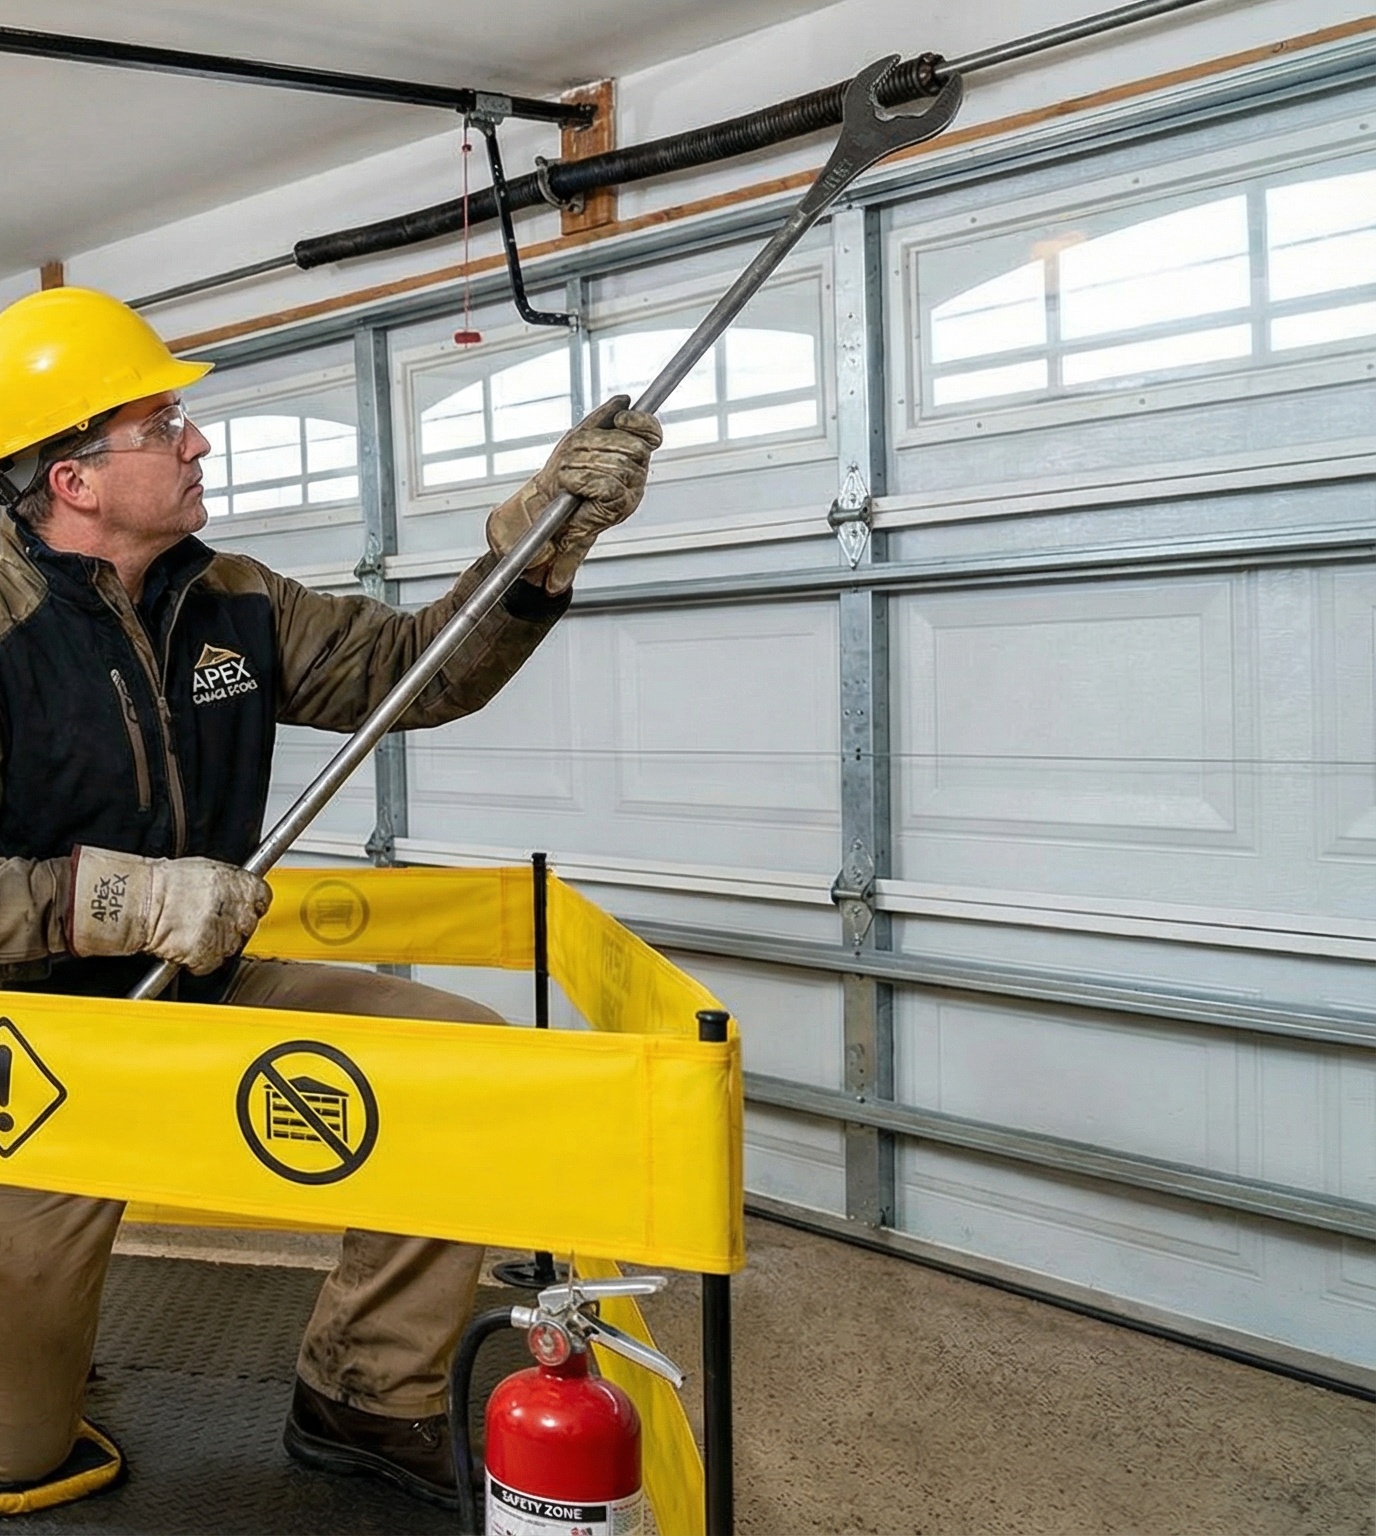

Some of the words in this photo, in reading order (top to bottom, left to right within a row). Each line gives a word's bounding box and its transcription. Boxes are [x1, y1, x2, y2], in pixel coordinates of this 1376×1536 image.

[193, 656, 252, 693] APEX
[109, 873, 130, 922] APEX
[501, 1490, 543, 1514] SAFETY
[544, 1504, 583, 1520] ZONE
